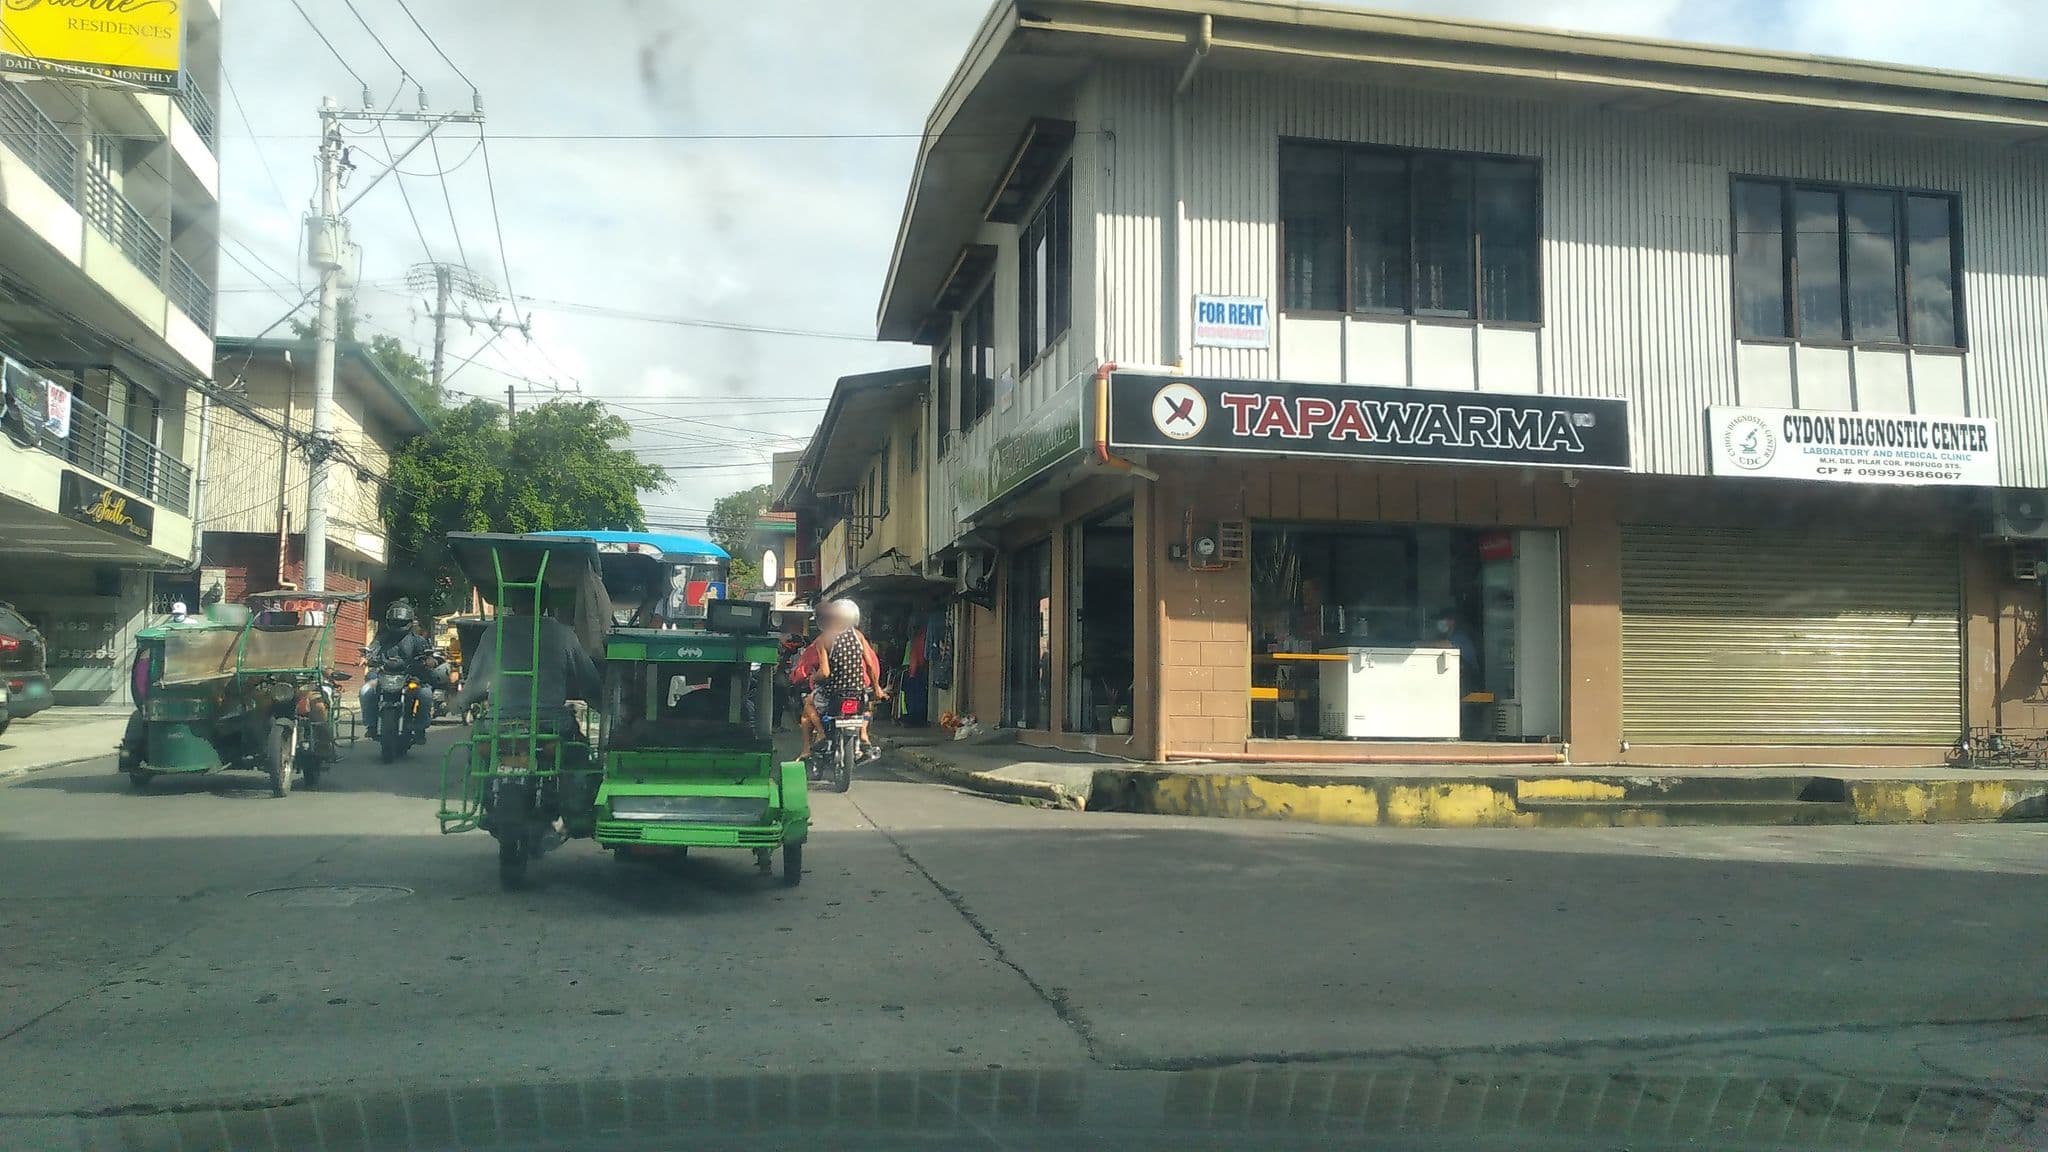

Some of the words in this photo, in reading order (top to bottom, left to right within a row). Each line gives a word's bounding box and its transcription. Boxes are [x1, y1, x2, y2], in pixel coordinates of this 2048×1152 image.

[68, 17, 172, 39] RESIDENCES
[5, 58, 42, 71] DAILY
[111, 70, 173, 83] MONTHLY
[1199, 301, 1225, 324] FOR
[1228, 303, 1264, 326] RENT
[1221, 391, 1585, 452] TAPAWARMA
[1783, 414, 1835, 445] CYDON
[1838, 417, 1928, 449] DIAGNOSTIC
[1931, 421, 1988, 452] CENTER
[1739, 456, 1761, 465] CDC
[1803, 447, 1870, 457] LABORATORY
[1872, 450, 1893, 458] AND
[1895, 450, 1938, 460] MEDICAL
[1940, 453, 1972, 461] CLINIC
[1904, 460, 1943, 468] PROFUGO
[1816, 466, 1838, 475] CP
[1857, 468, 1962, 480] 09993686067
